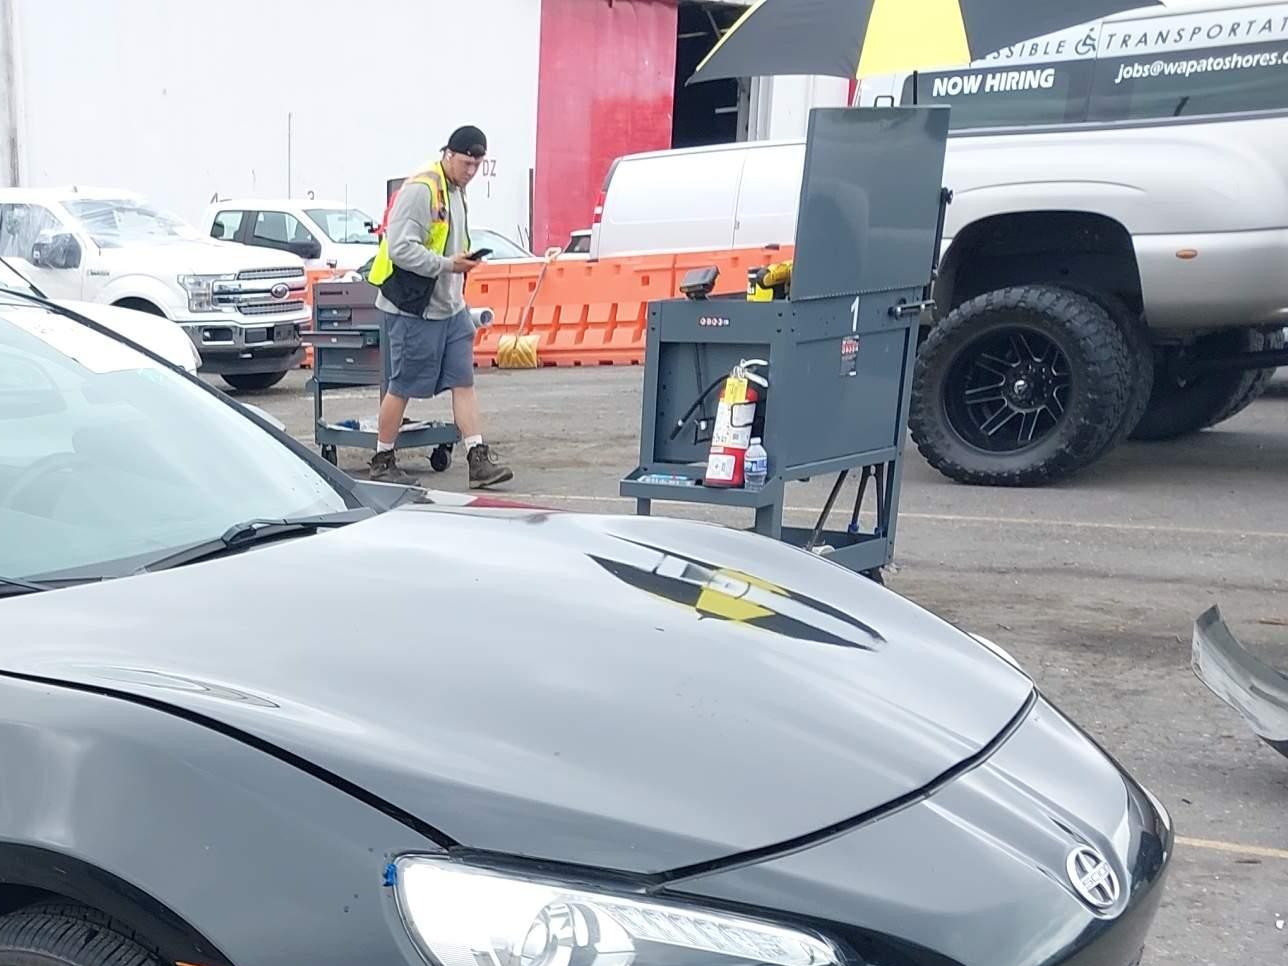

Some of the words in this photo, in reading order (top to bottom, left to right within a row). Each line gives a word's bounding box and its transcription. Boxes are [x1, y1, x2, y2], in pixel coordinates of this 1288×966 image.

[932, 74, 983, 97] NOW
[984, 68, 1056, 93] HIRING
[851, 295, 860, 332] 1
